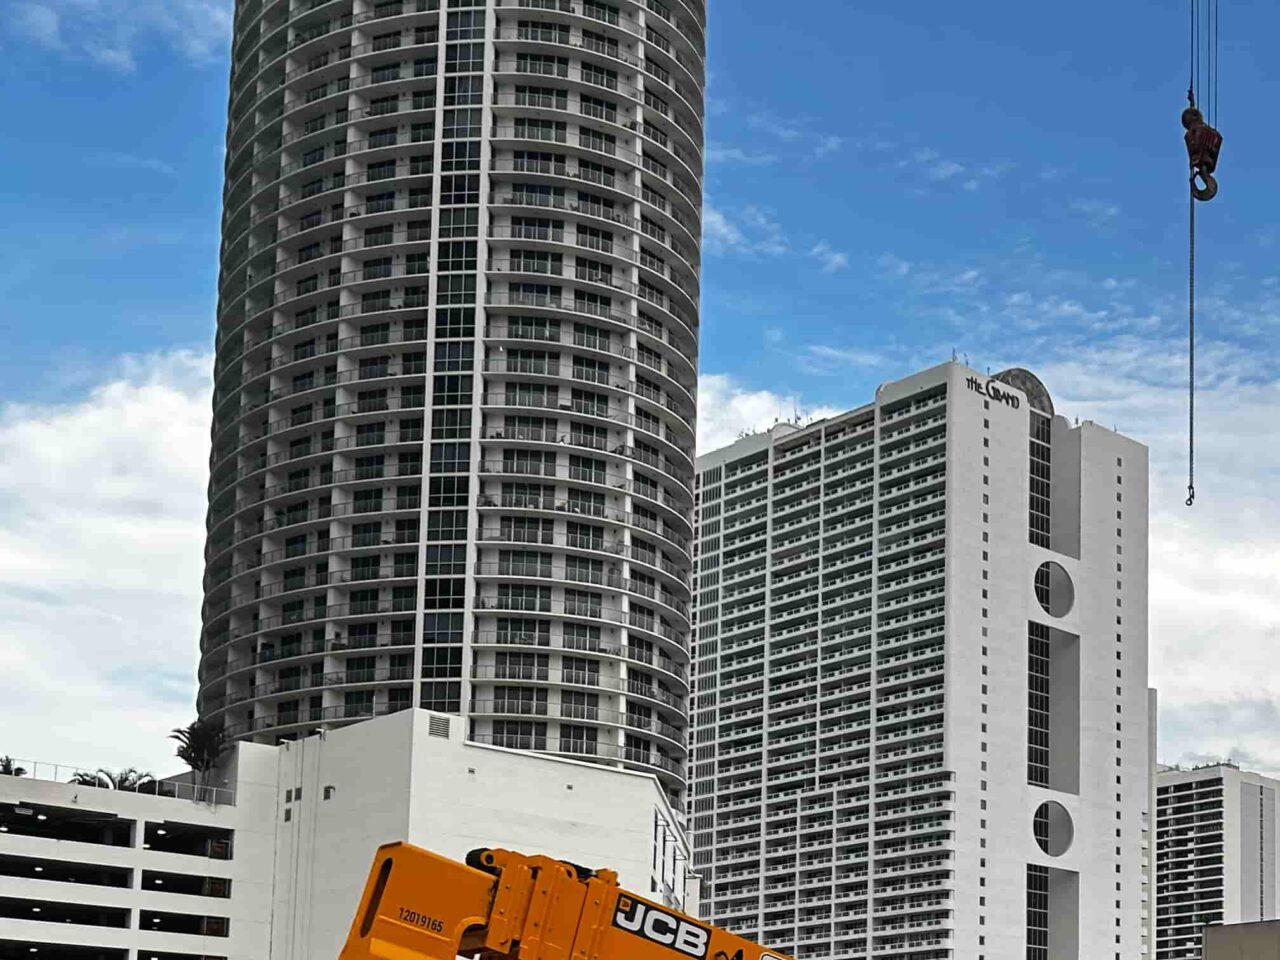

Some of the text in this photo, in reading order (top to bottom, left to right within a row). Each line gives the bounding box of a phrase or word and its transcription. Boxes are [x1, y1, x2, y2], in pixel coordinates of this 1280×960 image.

[966, 376, 1020, 410] THE GRAND
[399, 907, 444, 933] 12019165
[616, 904, 708, 957] JCB
